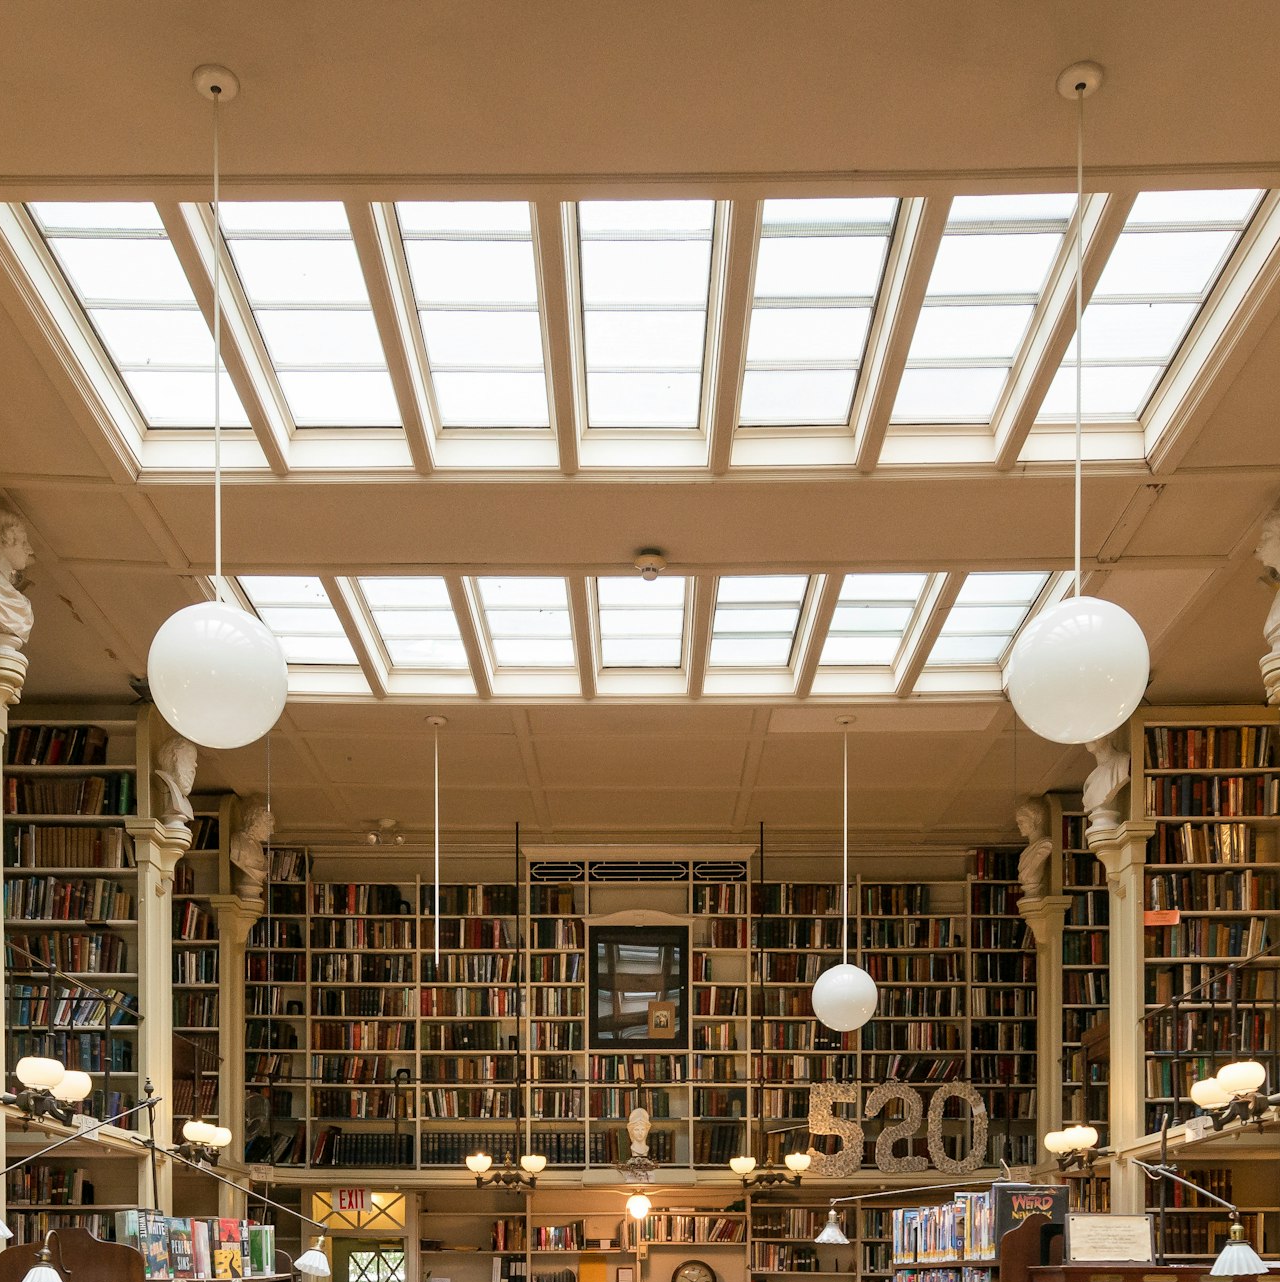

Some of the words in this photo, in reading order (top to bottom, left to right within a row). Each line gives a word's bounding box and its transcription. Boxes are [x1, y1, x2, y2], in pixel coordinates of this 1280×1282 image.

[807, 1082, 988, 1177] 520
[339, 1188, 366, 1210] EXIT
[1012, 1194, 1053, 1211] WEIRD
[148, 1224, 166, 1236] WHITE
[177, 1257, 190, 1271] SINS
